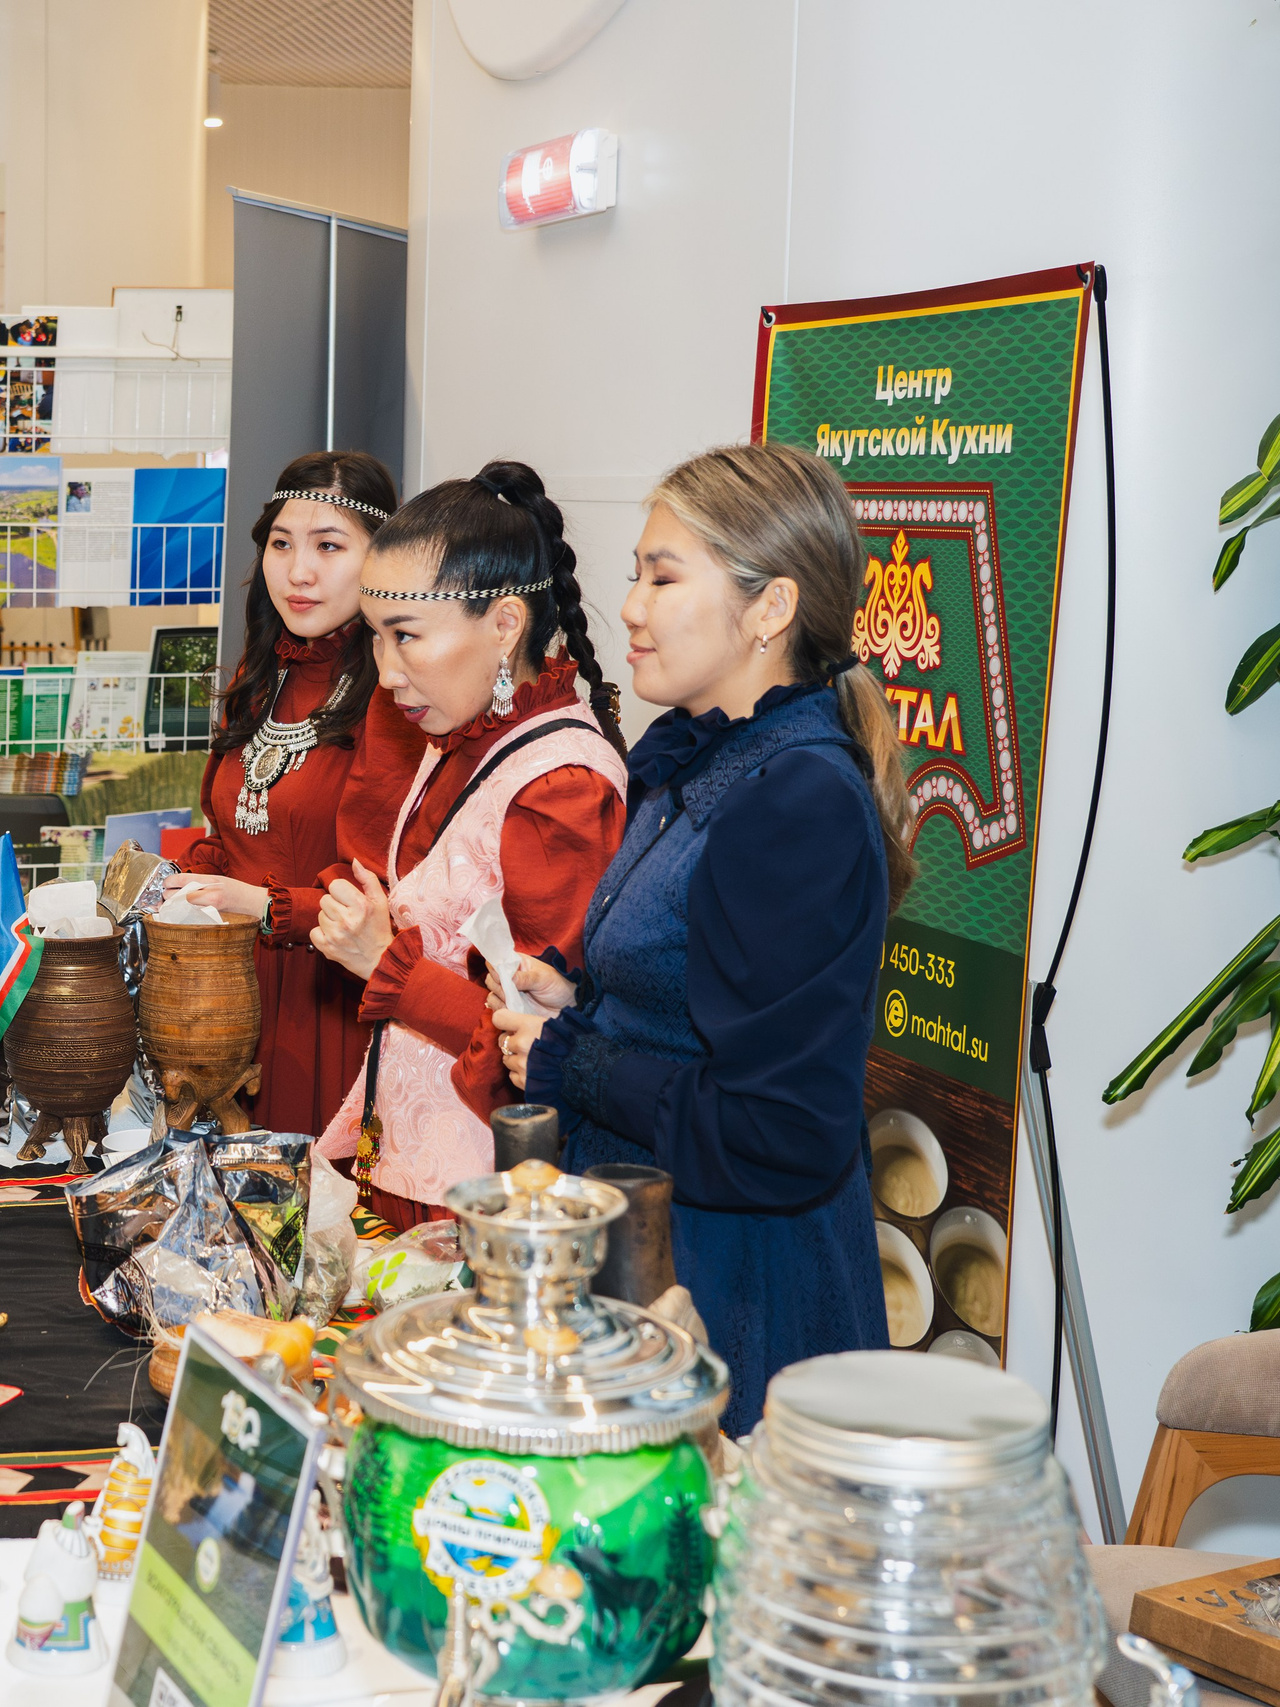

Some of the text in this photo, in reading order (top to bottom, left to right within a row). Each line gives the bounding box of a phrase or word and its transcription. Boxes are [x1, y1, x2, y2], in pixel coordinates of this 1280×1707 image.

[875, 365, 952, 406] Центр
[815, 415, 1013, 466] Якутской Кухни
[889, 942, 956, 988] 450-333
[911, 1014, 989, 1062] mahtal.su
